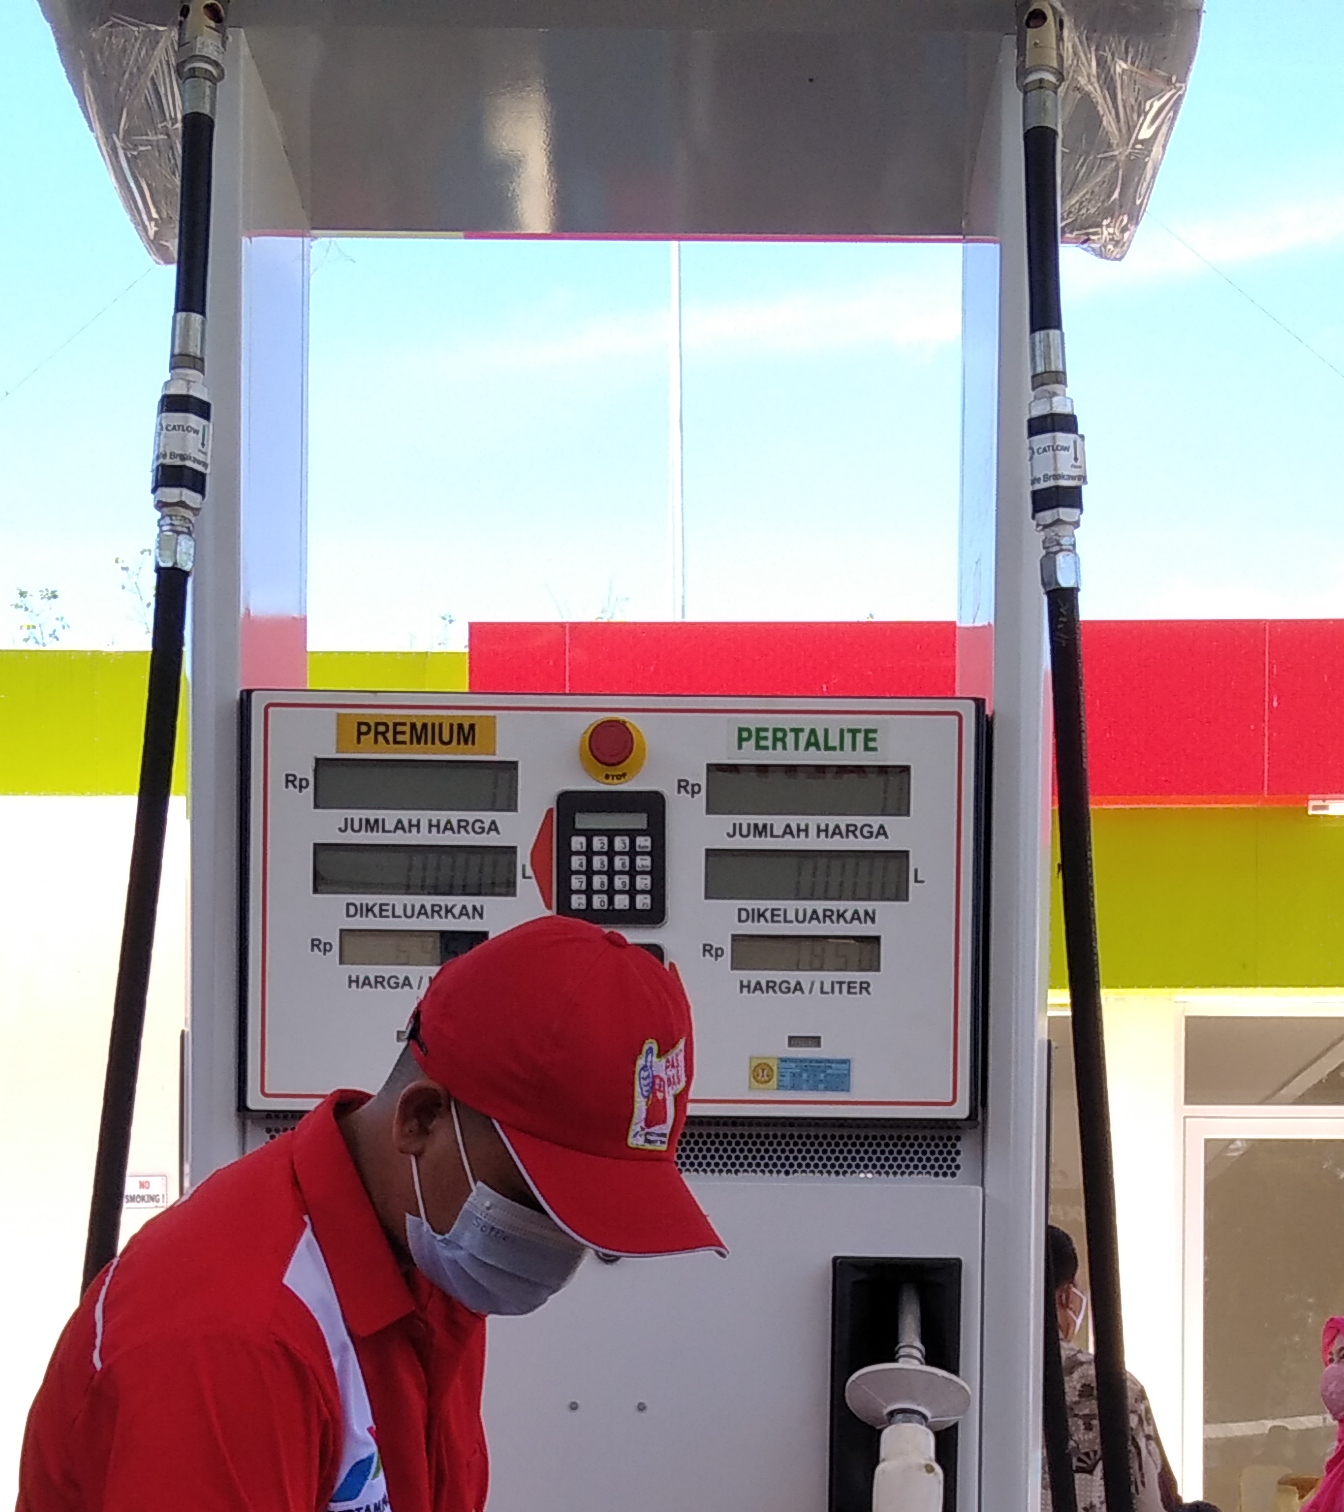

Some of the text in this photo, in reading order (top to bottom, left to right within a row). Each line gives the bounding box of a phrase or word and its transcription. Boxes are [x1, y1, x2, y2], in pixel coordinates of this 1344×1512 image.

[165, 423, 200, 436] CATLOW
[1036, 444, 1071, 456] CATLOW
[356, 722, 476, 746] PREMIUM
[737, 726, 879, 752] PERTALITE
[284, 773, 310, 793] Rp
[604, 772, 627, 781] STOP
[677, 778, 702, 798] Rp
[338, 817, 501, 835] JUMLAH HARGA
[726, 823, 889, 840] JUMLAH HARGA
[522, 864, 533, 879] L
[914, 868, 925, 884] L
[345, 902, 484, 920] DIKELUARKAN
[737, 907, 876, 925] DIKELUARKAN
[310, 938, 333, 956] Rp
[702, 943, 725, 961] Rp
[347, 974, 413, 990] HARGA
[739, 979, 805, 995] HARGA
[820, 980, 872, 995] LITER
[138, 1180, 150, 1190] NO
[125, 1193, 160, 1204] SMOKING
